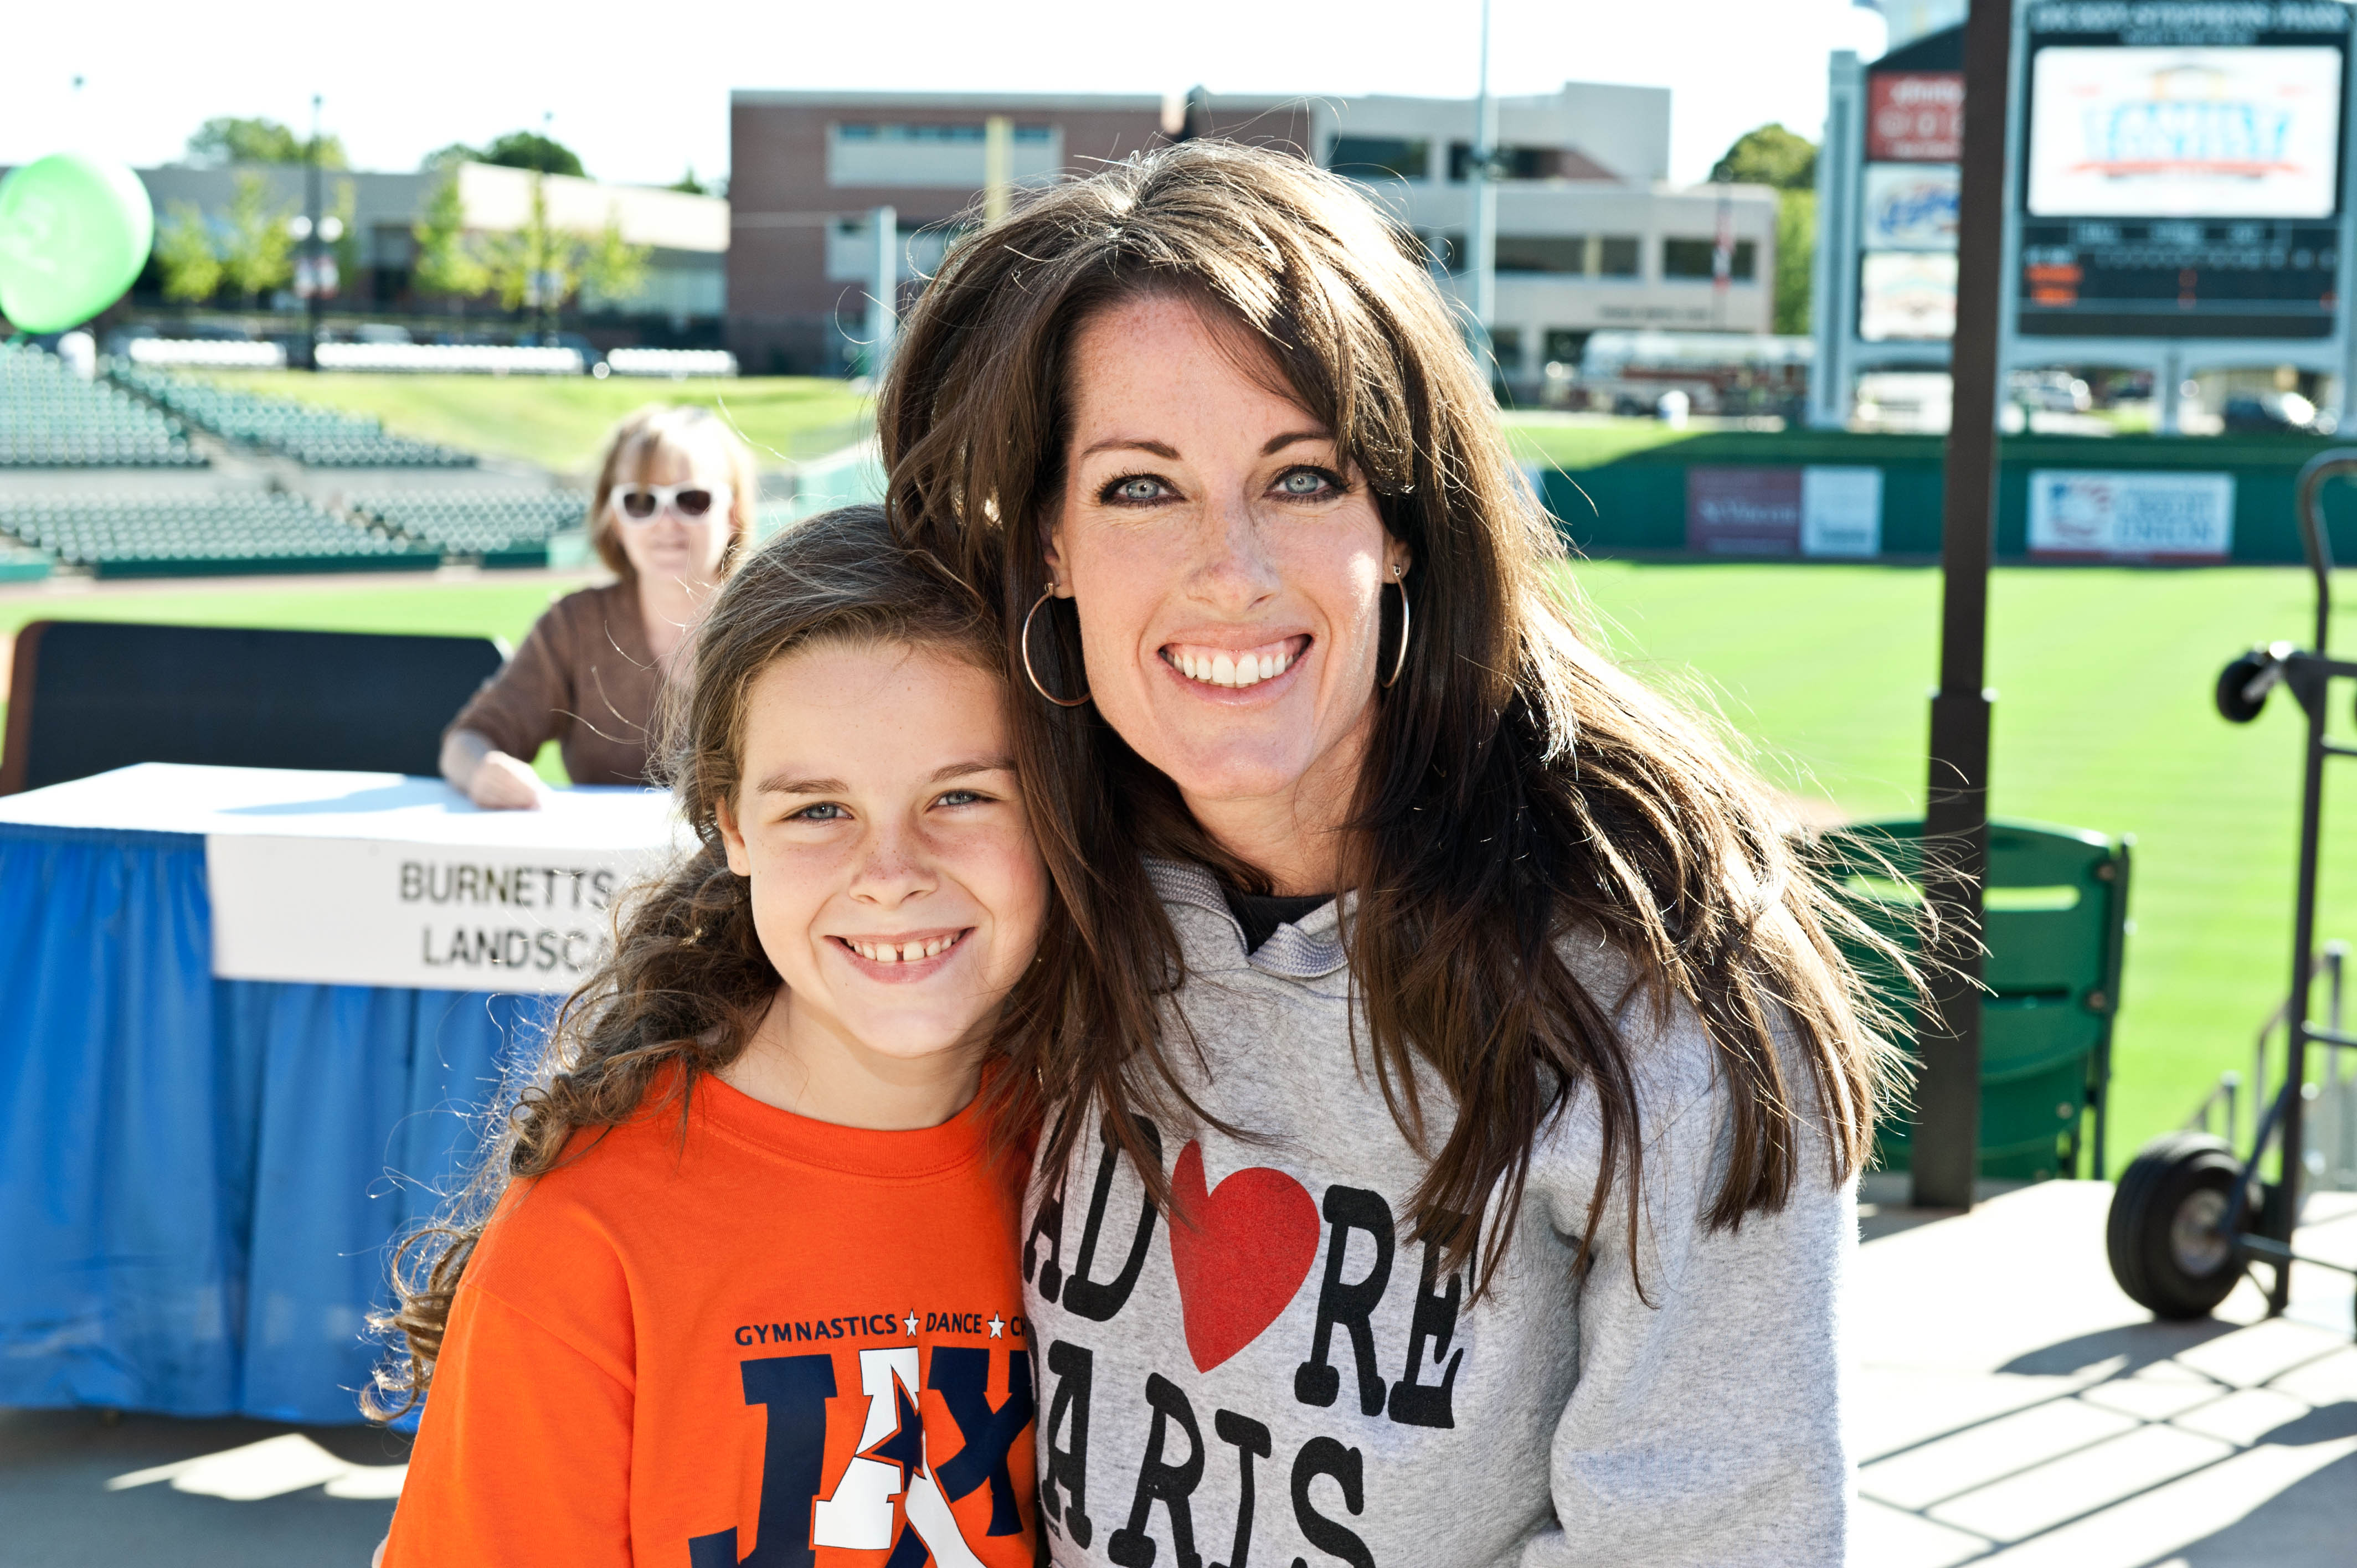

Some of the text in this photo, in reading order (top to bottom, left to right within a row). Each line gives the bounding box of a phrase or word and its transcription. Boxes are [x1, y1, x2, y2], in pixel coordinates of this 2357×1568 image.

[401, 862, 614, 910] BURNETTS
[423, 925, 605, 971] LANDSC
[734, 1313, 897, 1346] GYMNASTICS
[925, 1312, 982, 1334] DANCE
[688, 1345, 1035, 1568] JAX
[1026, 1315, 1376, 1568] ARIS
